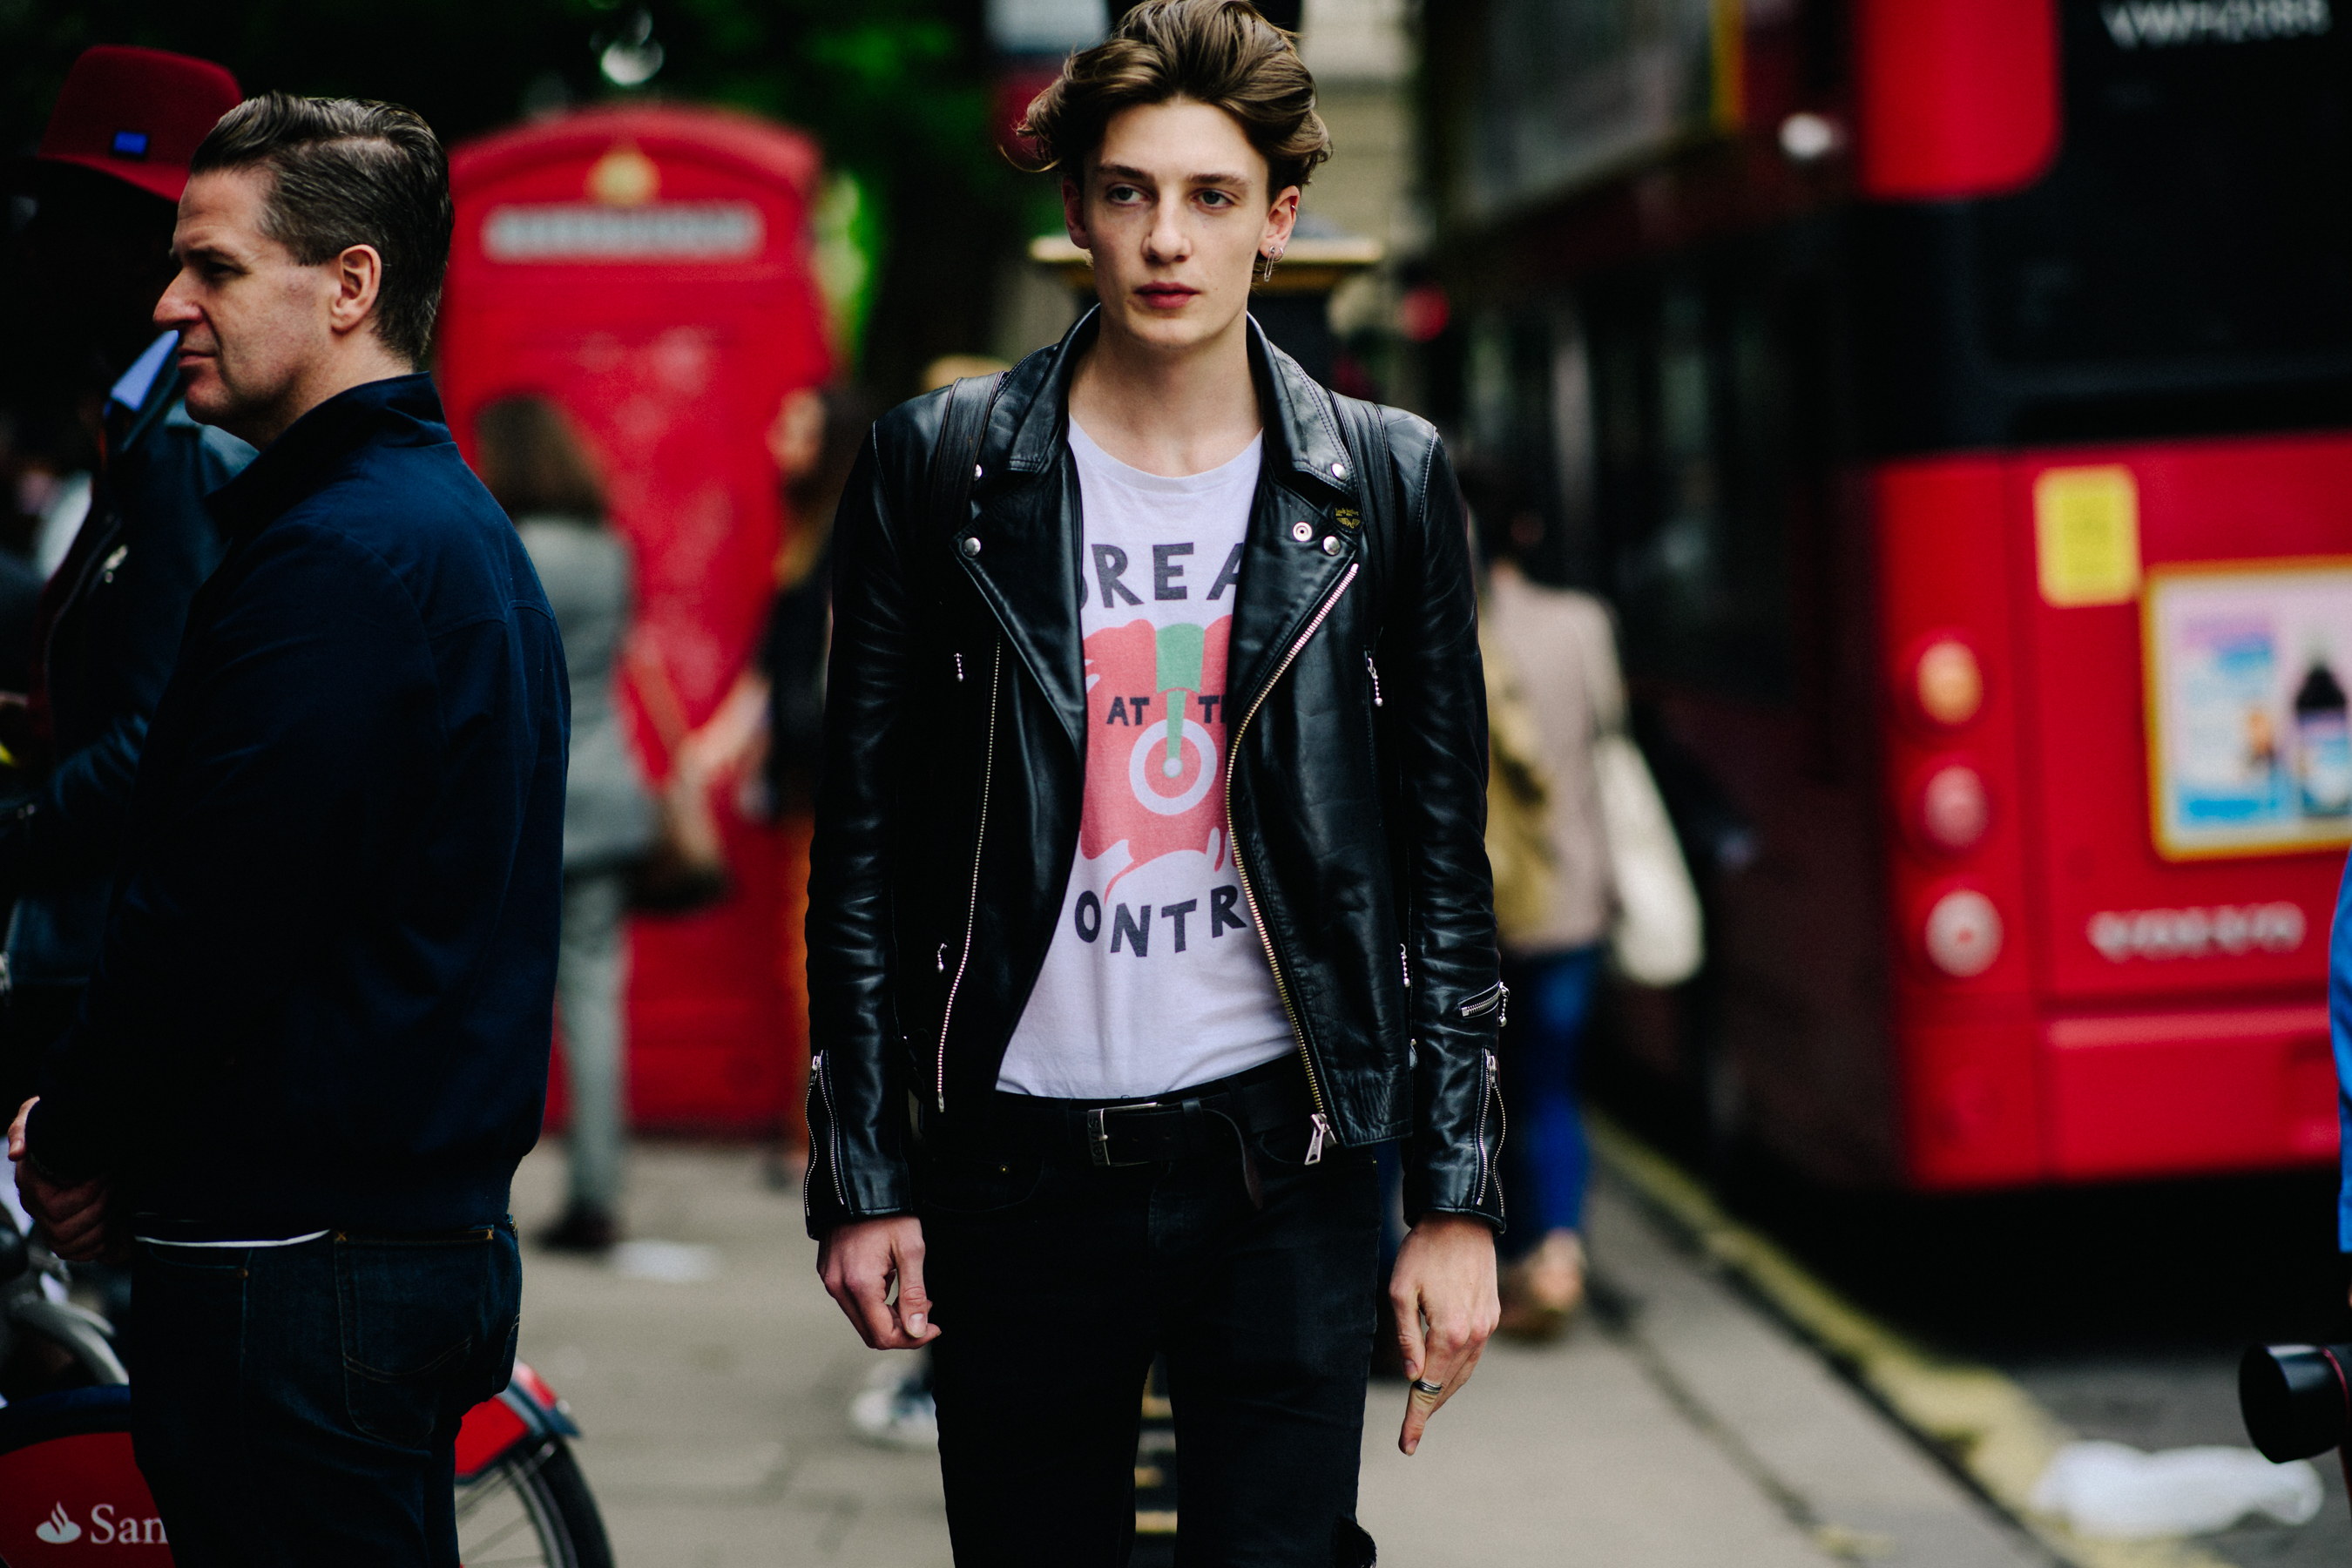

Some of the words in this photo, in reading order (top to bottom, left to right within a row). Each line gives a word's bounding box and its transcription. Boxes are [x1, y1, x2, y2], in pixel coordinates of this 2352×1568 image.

[1080, 542, 1244, 609] REA
[1106, 696, 1150, 727] AT
[1074, 884, 1247, 957] ONTR
[90, 1503, 169, 1544] San
